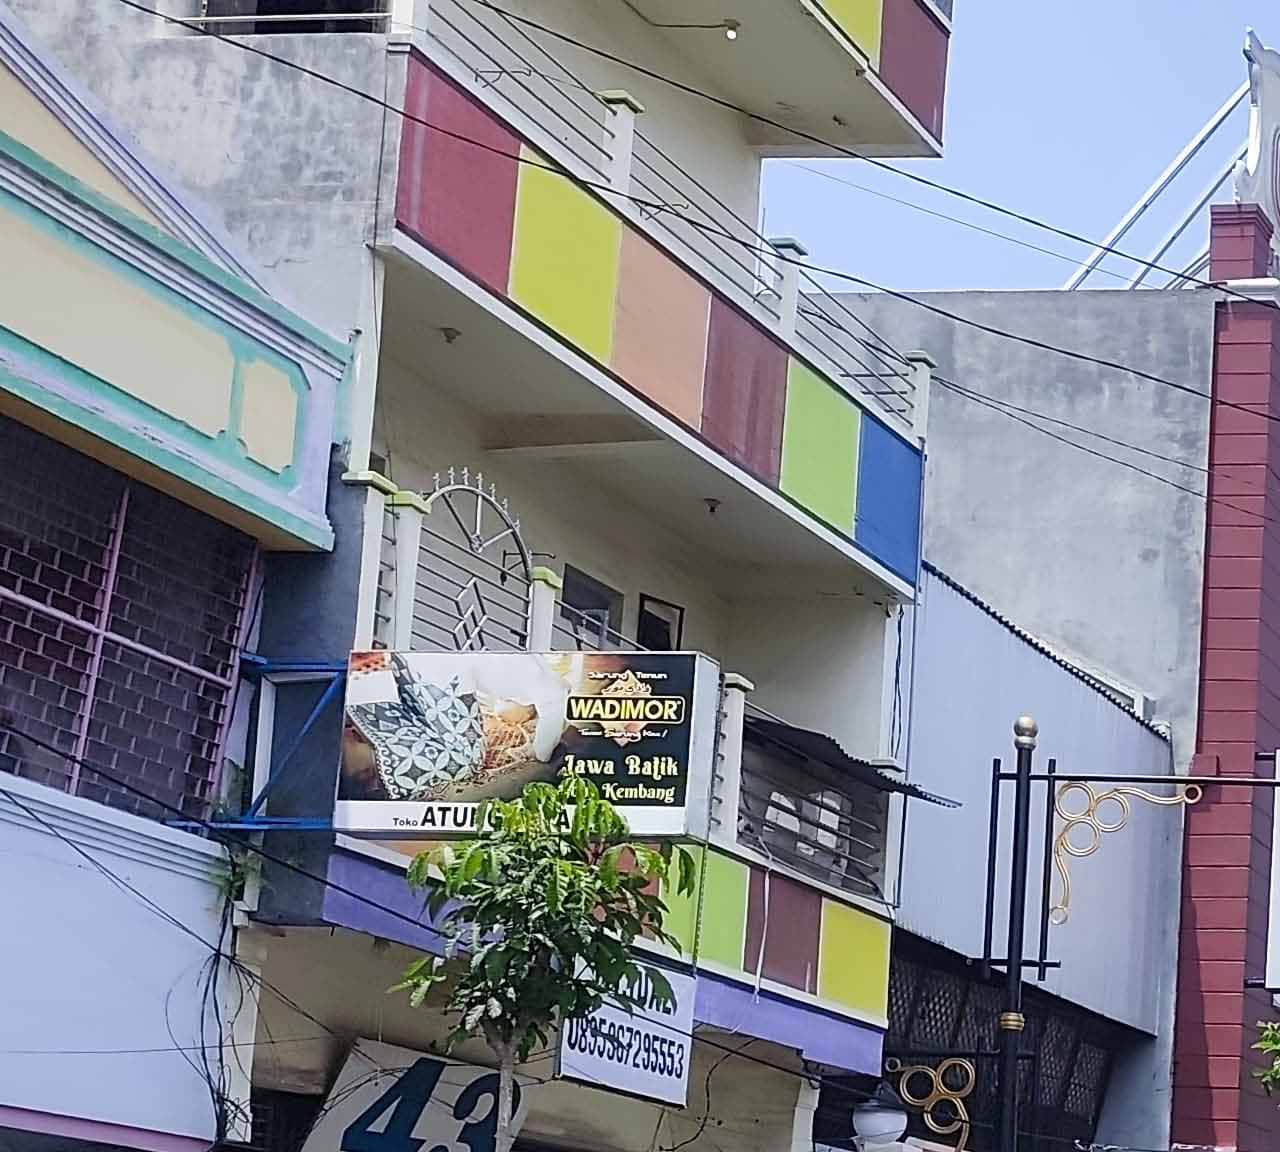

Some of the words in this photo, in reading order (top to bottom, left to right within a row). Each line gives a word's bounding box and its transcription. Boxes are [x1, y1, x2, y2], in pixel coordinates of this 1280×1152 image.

[569, 699, 681, 720] WADIMOR
[564, 755, 615, 777] Jawa
[625, 755, 679, 780] Batik
[601, 783, 676, 804] Kembang
[393, 817, 418, 827] Toko
